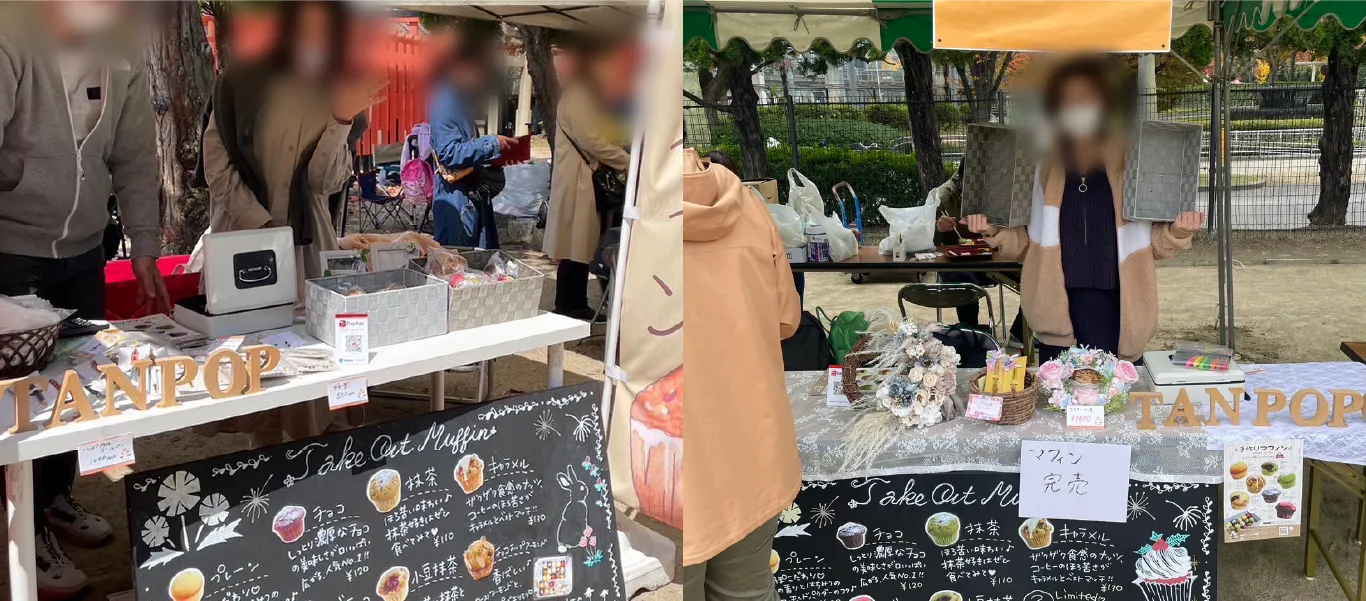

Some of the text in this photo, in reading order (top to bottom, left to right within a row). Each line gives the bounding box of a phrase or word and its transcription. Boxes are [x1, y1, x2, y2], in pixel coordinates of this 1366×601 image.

[0, 344, 281, 434] TANPOP
[1130, 387, 1366, 430] TANPOP
[286, 422, 493, 480] Take Out Muffin
[1029, 449, 1083, 465] マフィン
[488, 456, 530, 474] キャラメル
[405, 467, 438, 491] 抹茶
[1043, 472, 1089, 495] 完売
[851, 477, 928, 506] Take
[931, 482, 976, 506] Out
[313, 504, 345, 522] チョコ
[873, 527, 903, 540] チョコ
[965, 519, 1000, 536] 抹茶
[1060, 523, 1110, 541] キャラメル
[434, 532, 455, 547] ¥110
[785, 551, 825, 564] プレーン
[941, 555, 1010, 570] 抹茶好きはぜひ
[211, 563, 260, 583] プレーン
[346, 565, 369, 582] ¥120
[411, 555, 458, 584] 小豆抹茶
[900, 581, 923, 591] ¥120
[990, 576, 1013, 587] ¥110
